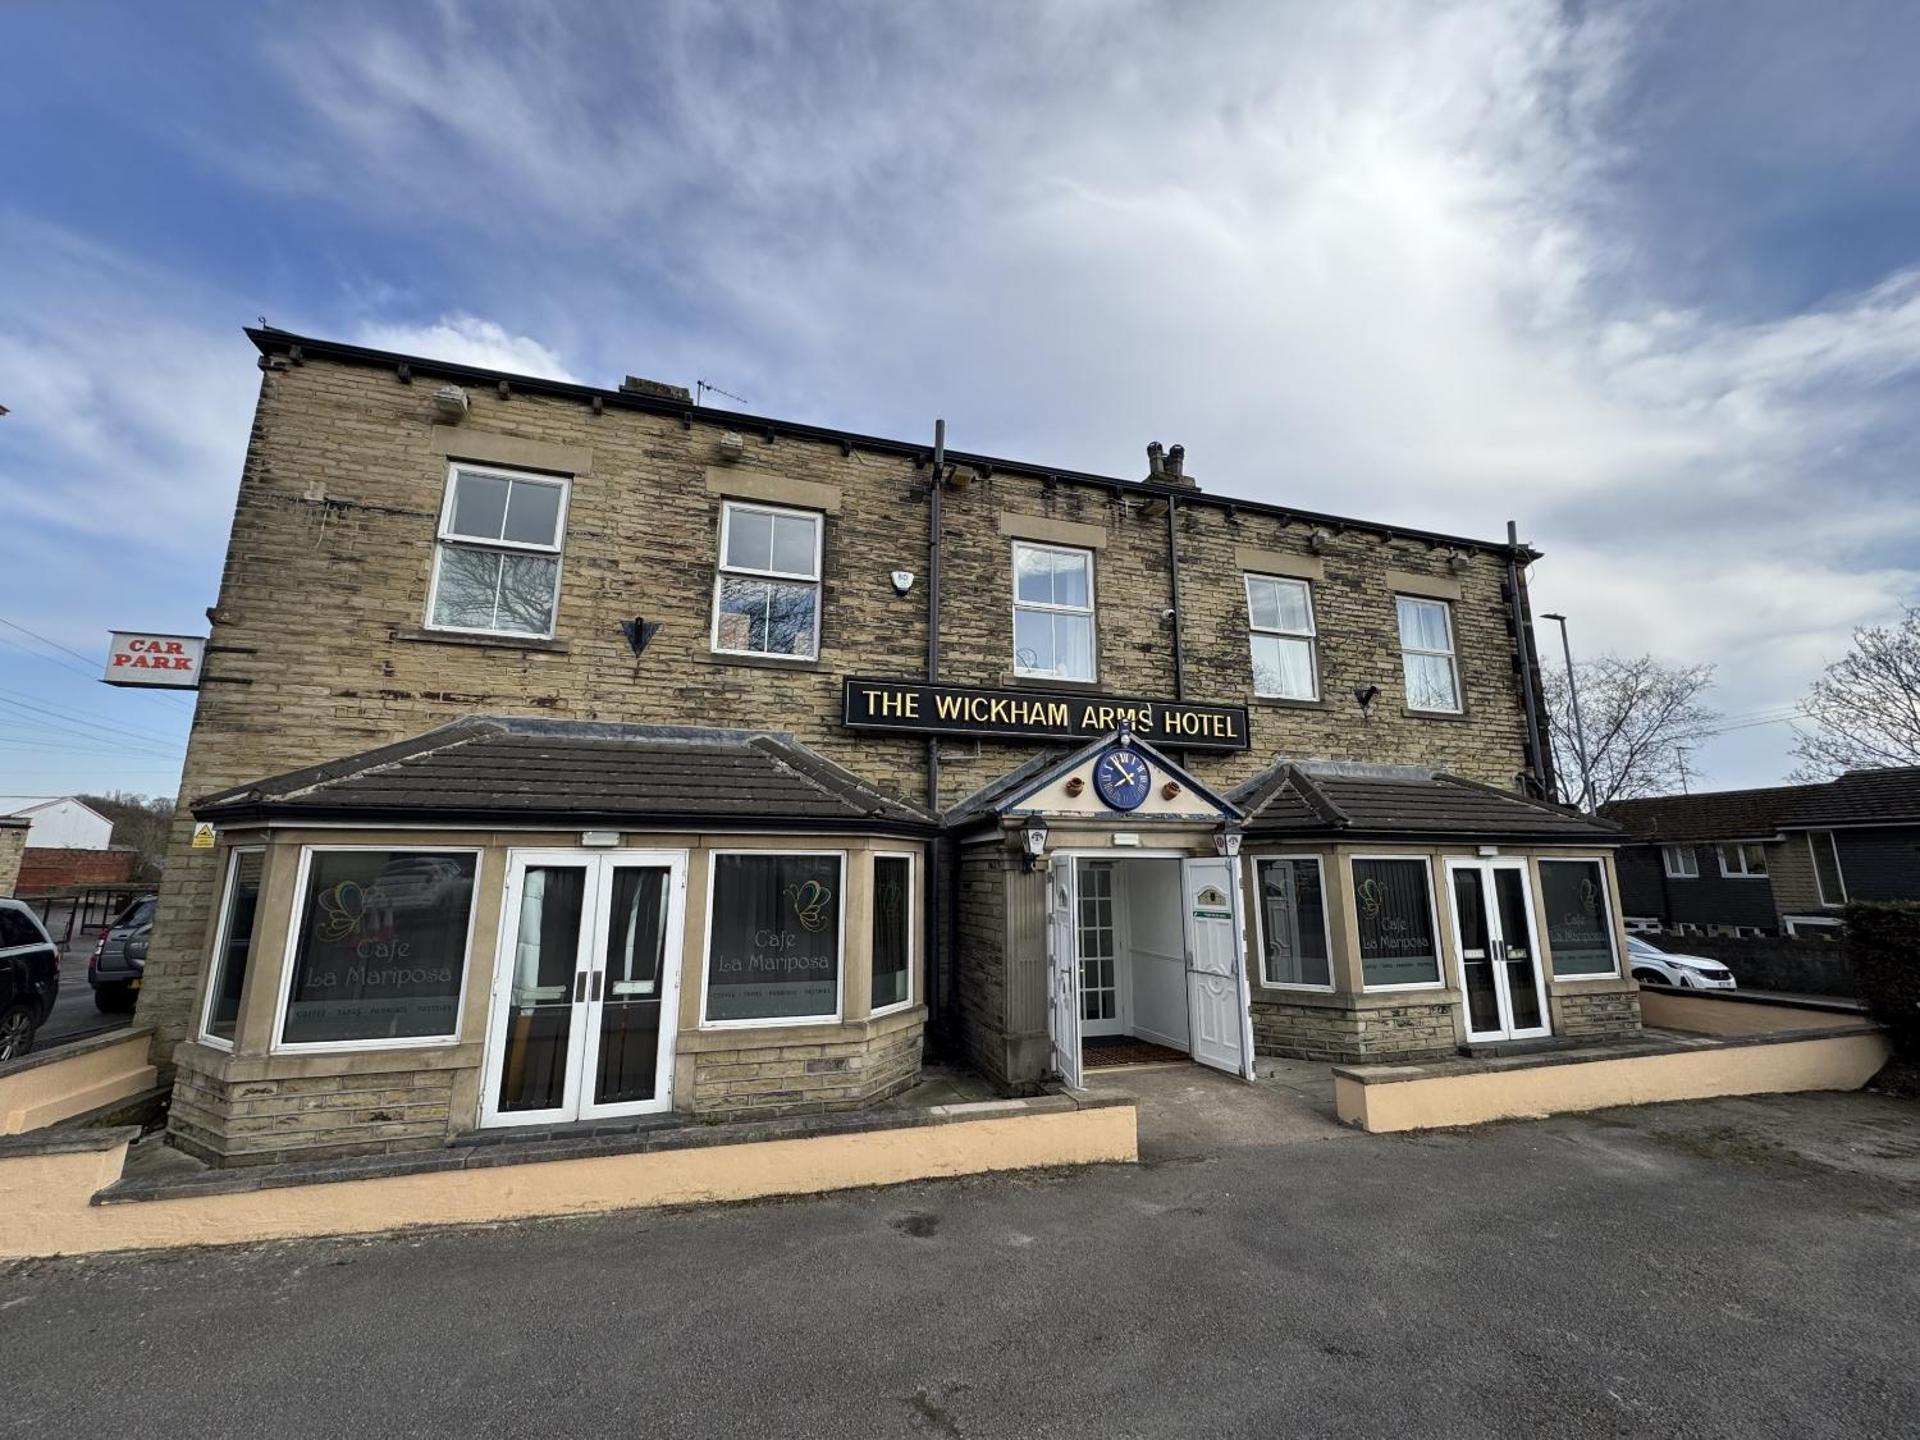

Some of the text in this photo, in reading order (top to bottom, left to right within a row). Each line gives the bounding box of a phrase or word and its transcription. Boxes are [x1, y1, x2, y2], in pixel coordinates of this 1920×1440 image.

[128, 639, 184, 654] CAR
[113, 653, 193, 670] PARK
[862, 690, 1238, 738] THE WICKHAM ARMS HOTEL
[356, 937, 410, 963] Cafe
[754, 929, 797, 951] Cafe
[719, 954, 829, 973] La Mariposa
[305, 966, 452, 989] La Mariposa
